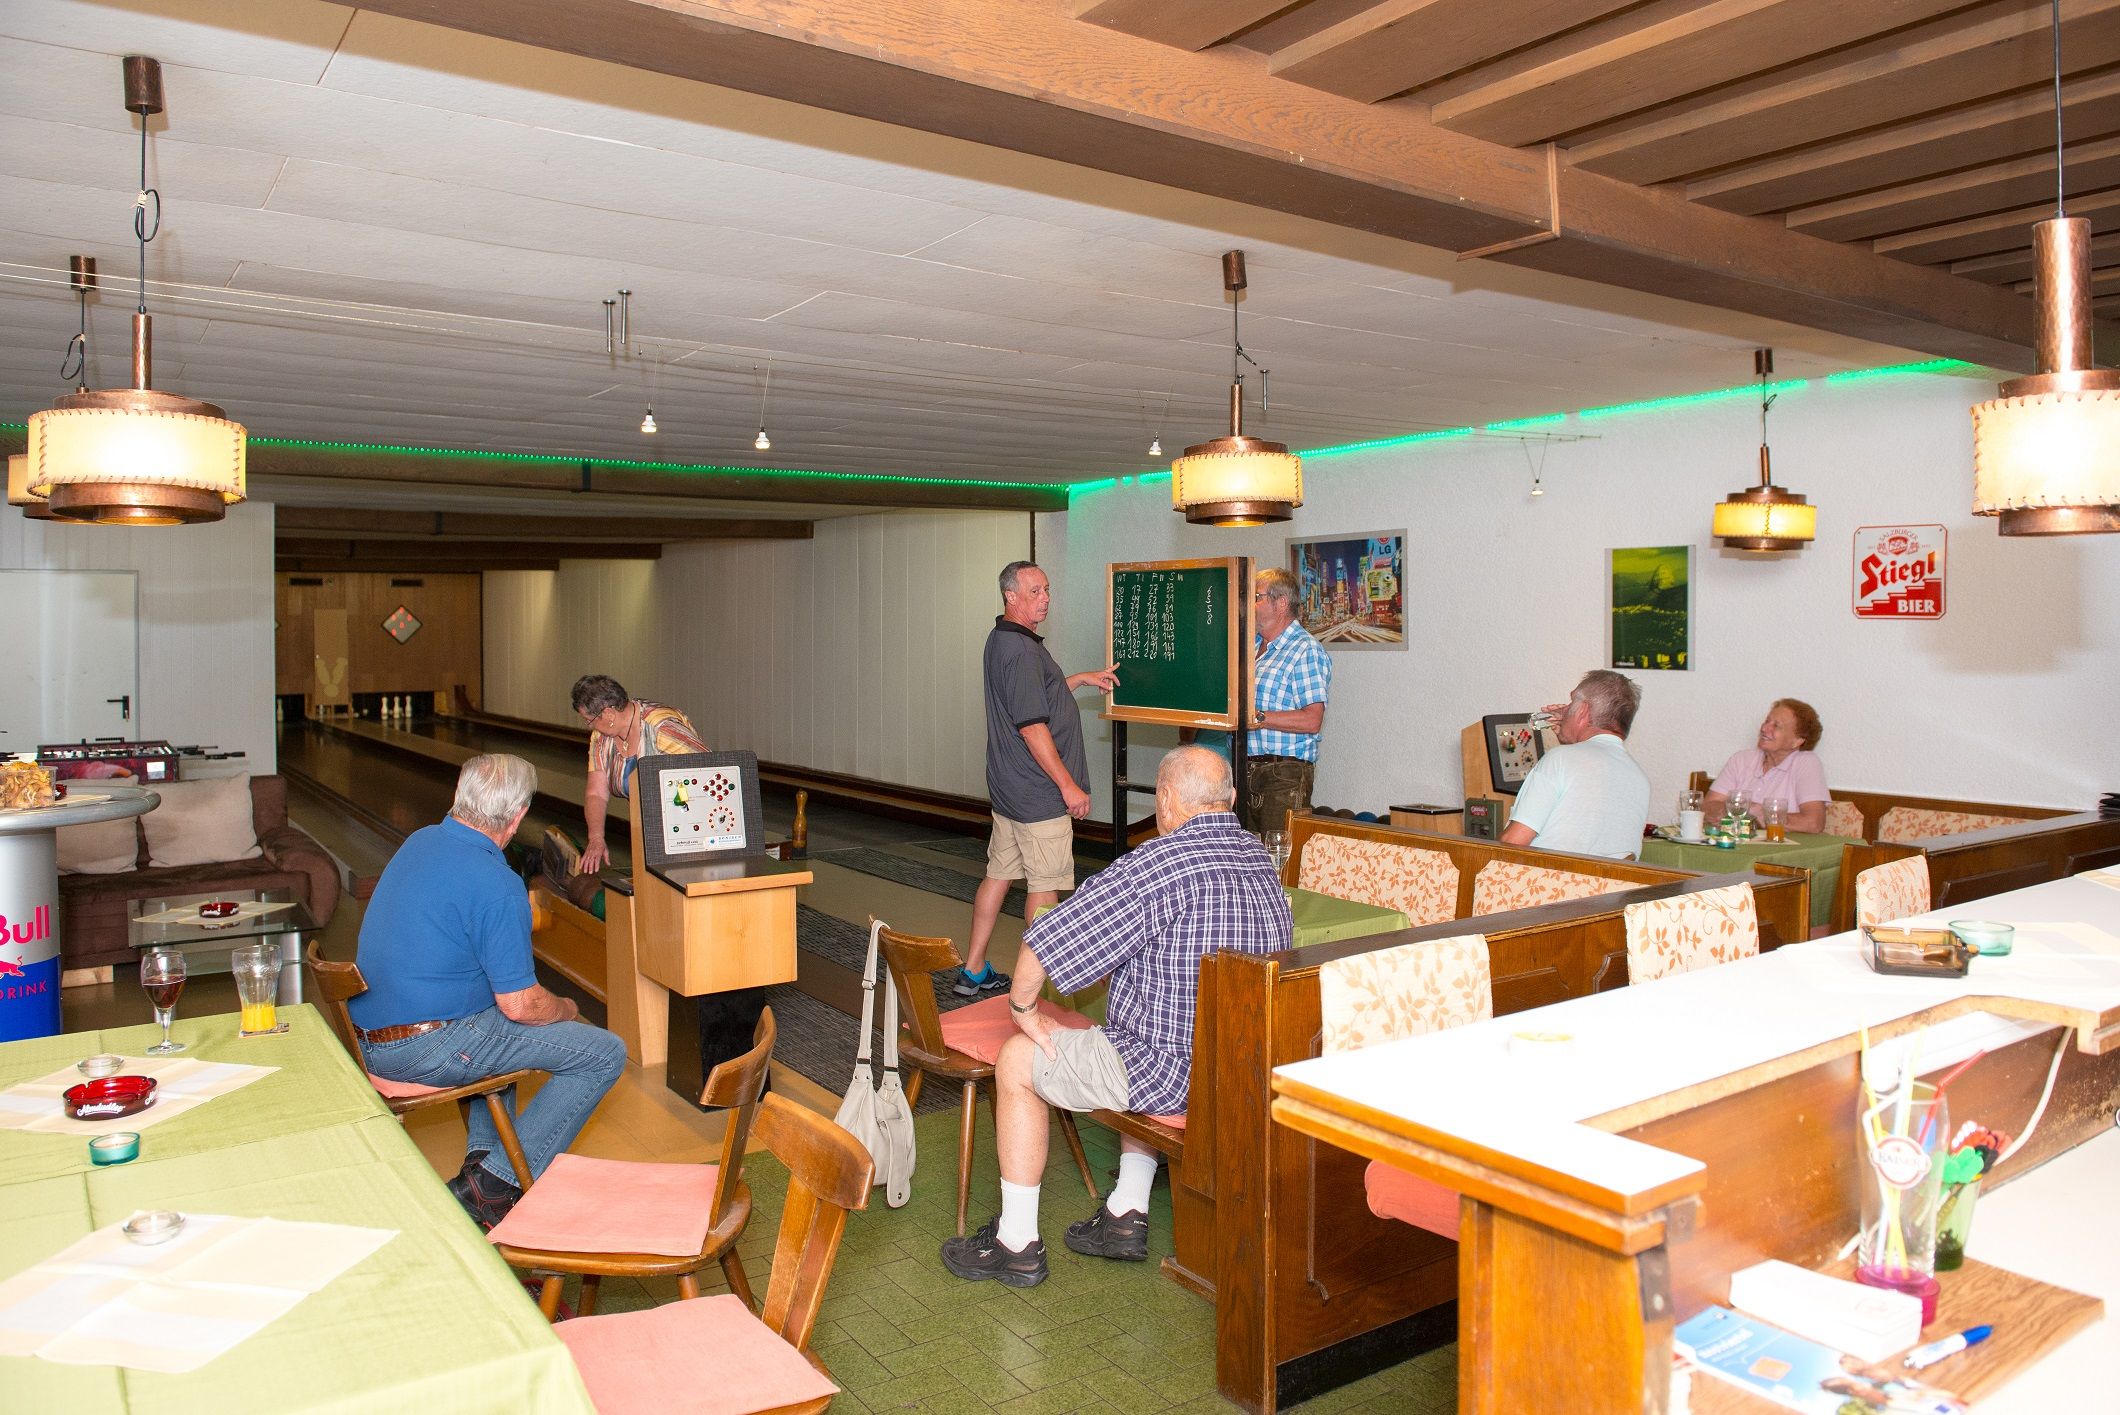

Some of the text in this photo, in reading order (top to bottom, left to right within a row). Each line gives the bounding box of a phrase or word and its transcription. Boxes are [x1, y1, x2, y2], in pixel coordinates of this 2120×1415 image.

[1379, 545, 1391, 554] LG
[1861, 551, 1936, 600] Stiegl
[1132, 584, 1141, 594] 17
[1149, 584, 1158, 594] 27
[1116, 596, 1124, 604] 35
[1149, 595, 1157, 605] 52
[1147, 603, 1157, 613] 76
[1898, 600, 1936, 613] BIER
[1162, 612, 1174, 622] 103
[1207, 613, 1213, 625] 8
[1145, 621, 1158, 630] 131
[1162, 623, 1175, 631] 120
[1114, 629, 1124, 637] 122
[1163, 632, 1175, 641] 143
[1113, 638, 1125, 648] 147
[1127, 638, 1141, 649] 180
[1162, 642, 1174, 652] 161
[1128, 649, 1139, 659] 212
[1144, 649, 1157, 659] 220
